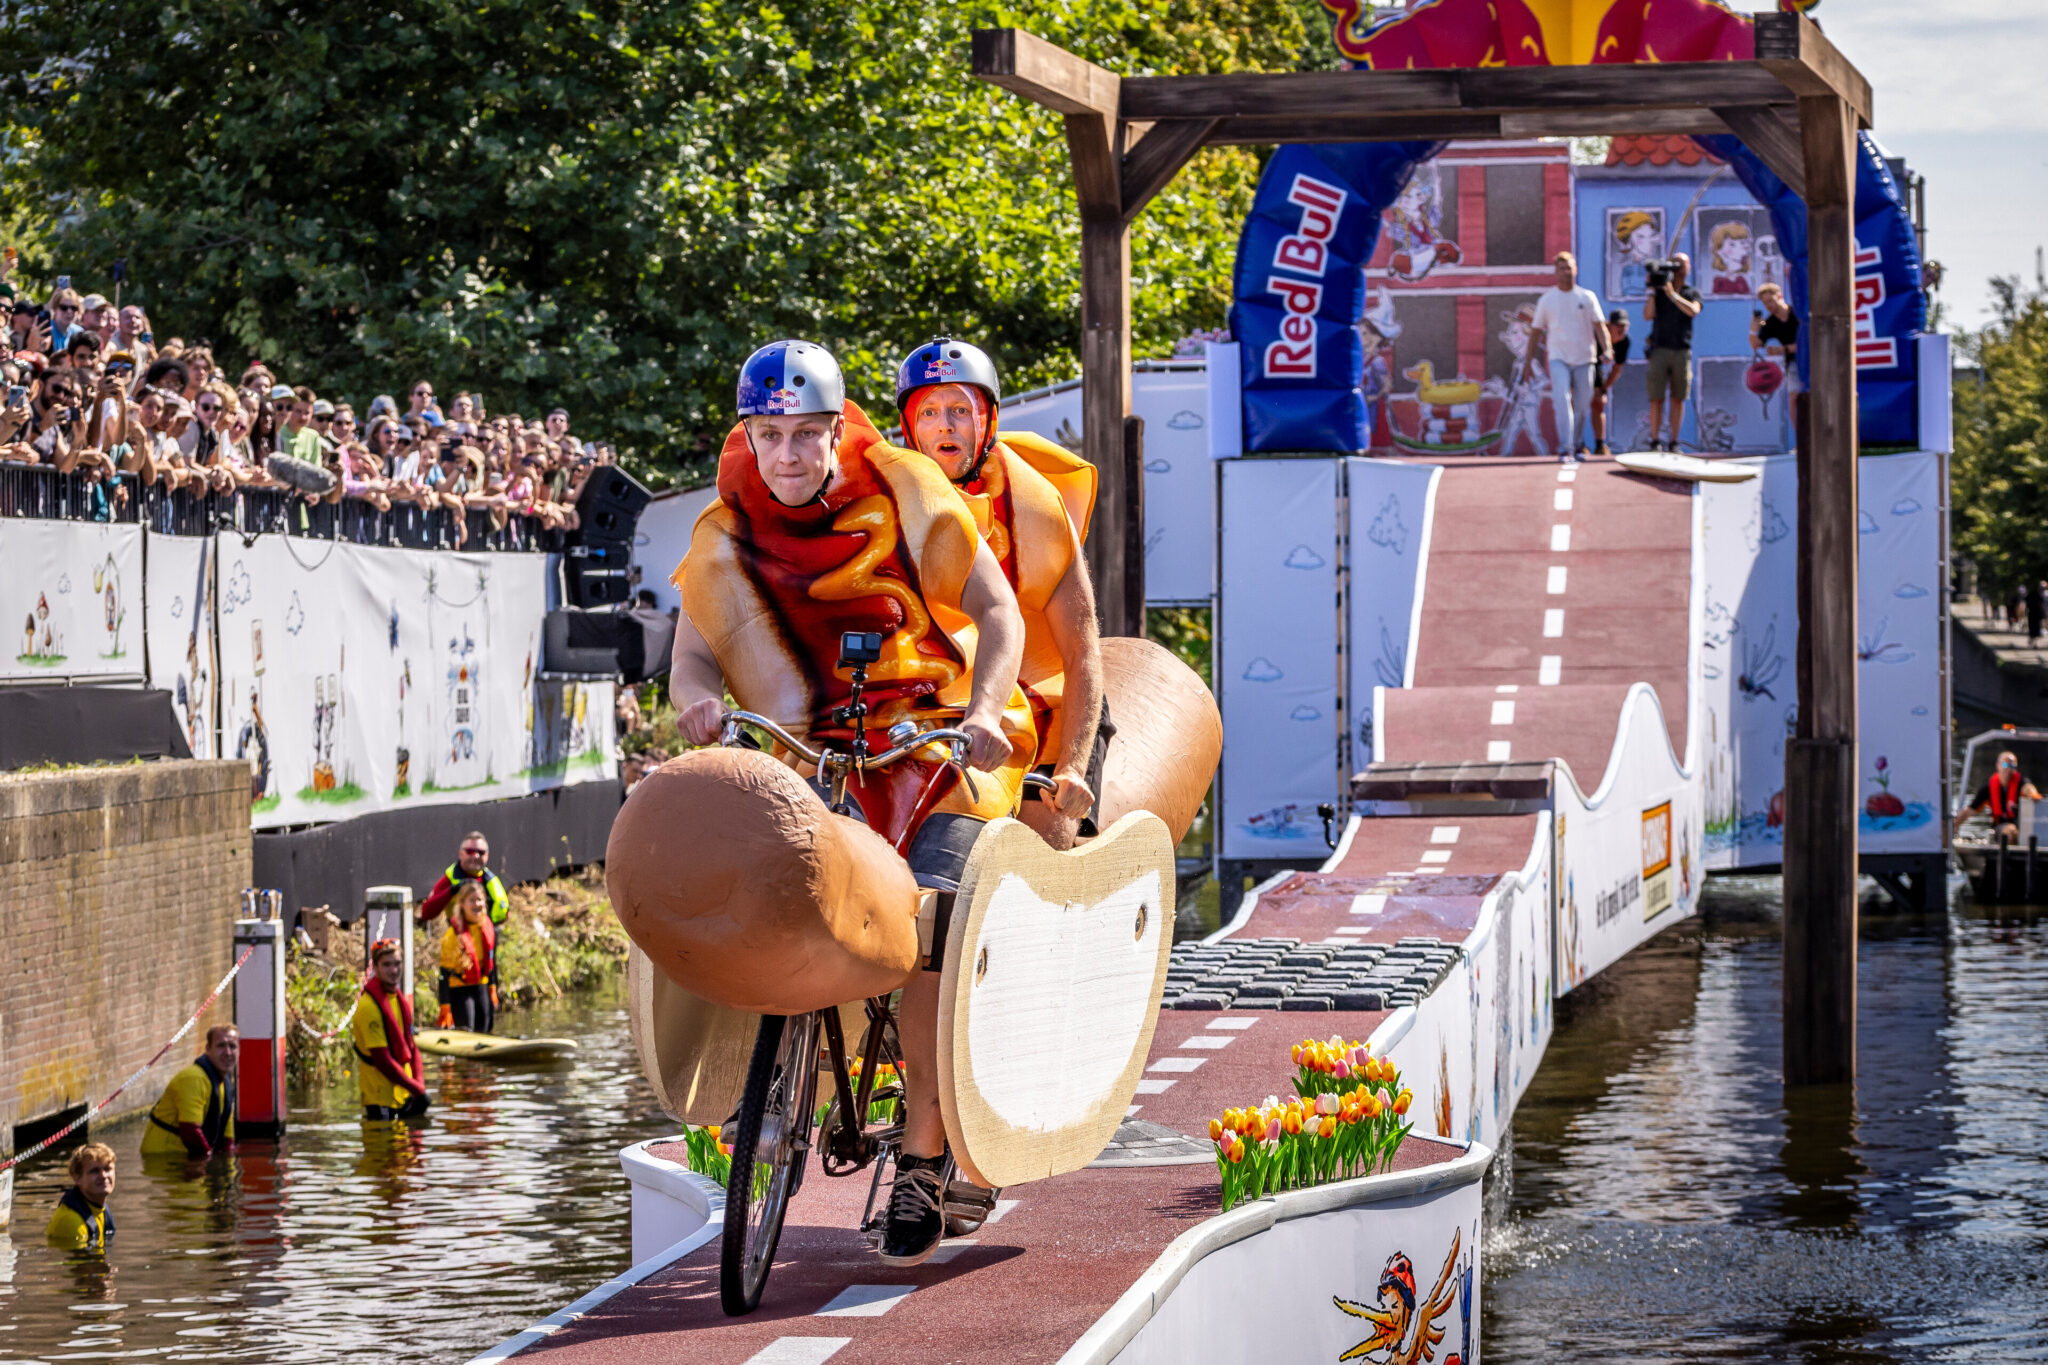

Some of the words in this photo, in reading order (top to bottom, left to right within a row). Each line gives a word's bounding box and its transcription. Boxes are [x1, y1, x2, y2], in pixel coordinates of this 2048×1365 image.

[1273, 173, 1348, 277] Bull
[1265, 276, 1322, 377] Red
[925, 368, 941, 378] Red
[941, 368, 957, 377] Bull
[768, 399, 784, 409] Red
[785, 399, 801, 408] Bull
